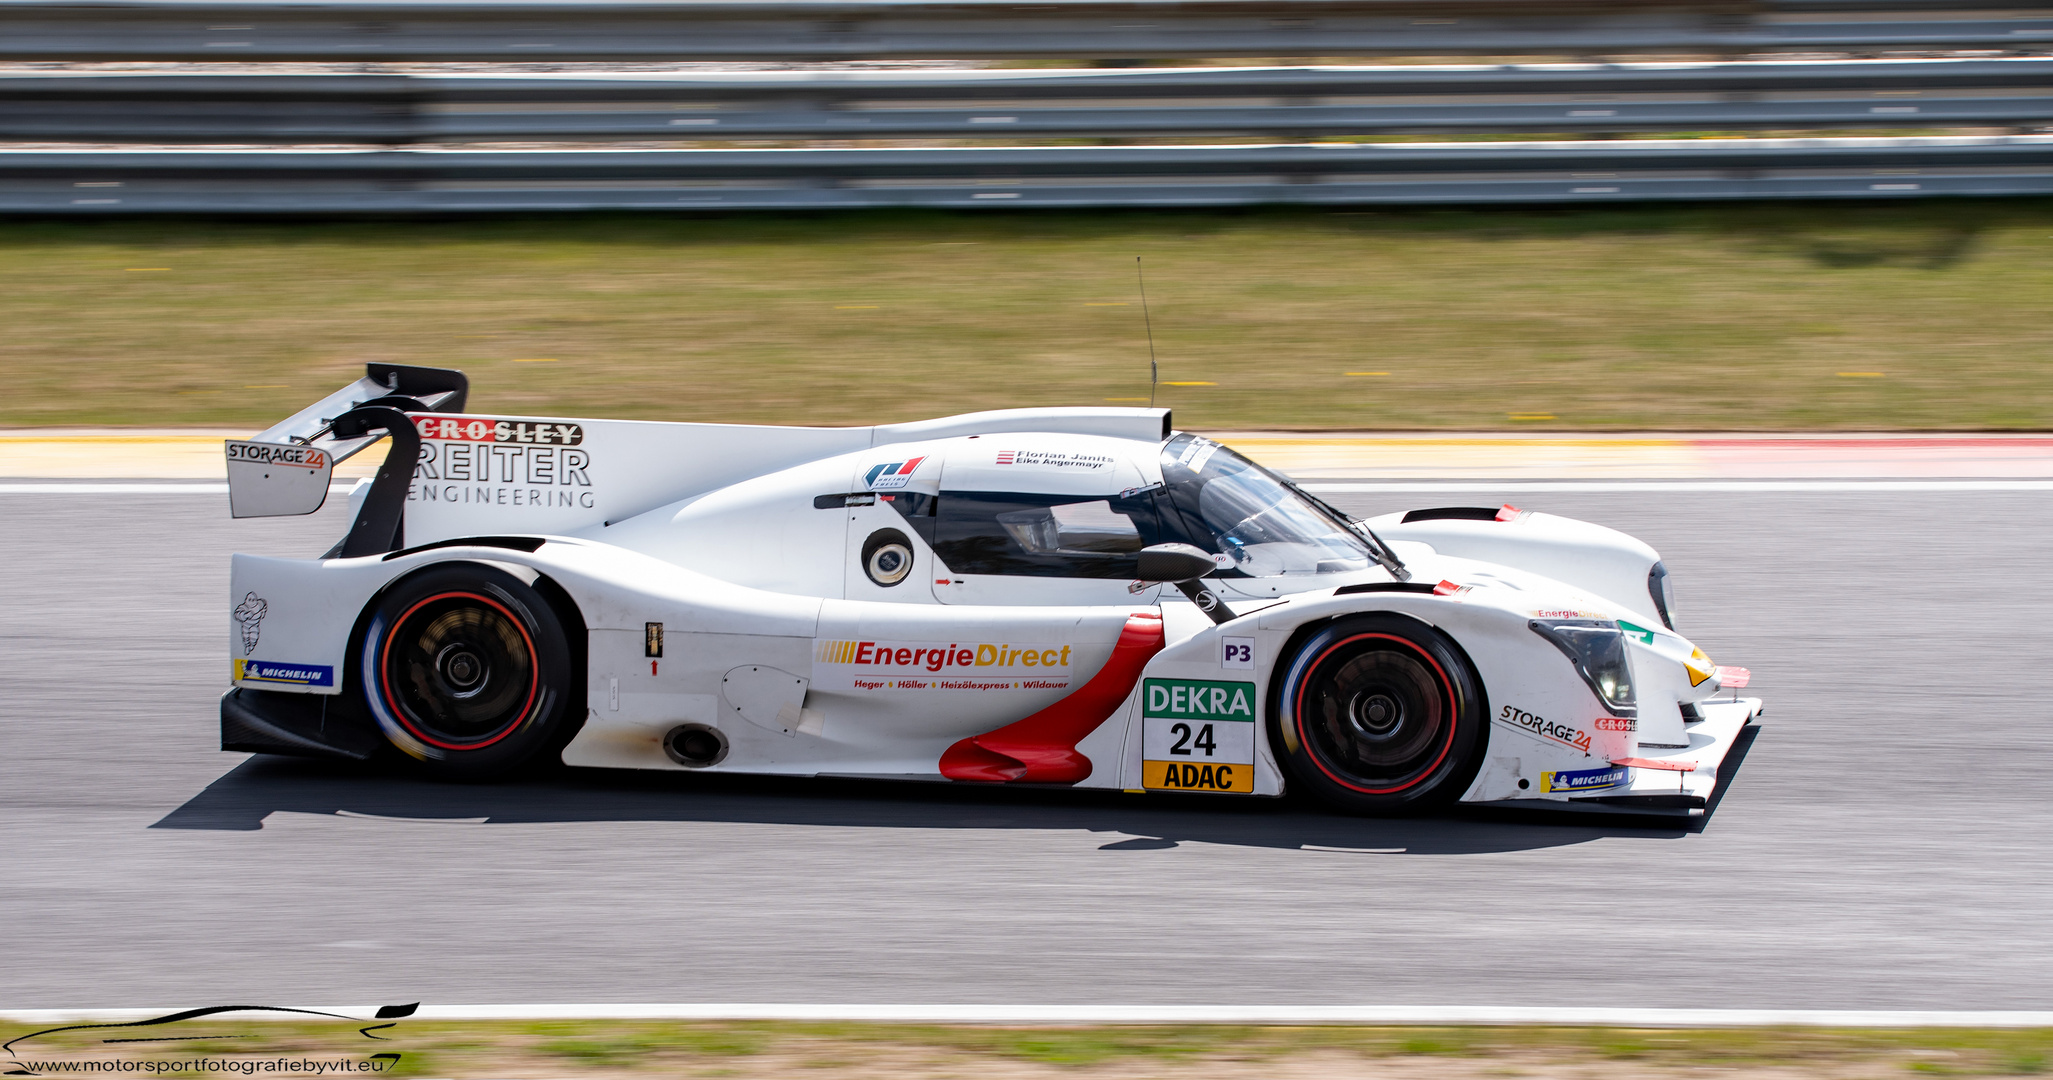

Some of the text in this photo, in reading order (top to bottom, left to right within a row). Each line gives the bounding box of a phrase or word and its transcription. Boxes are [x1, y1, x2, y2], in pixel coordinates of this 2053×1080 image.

[416, 418, 582, 445] CROSLEY
[228, 444, 325, 469] STORAGE24
[411, 442, 593, 487] REITER
[1017, 450, 1115, 463] Florian Janits
[1042, 459, 1104, 469] Angermayr
[407, 484, 595, 509] ENGINEERING
[854, 641, 1072, 672] EnergieDirect
[1225, 644, 1251, 662] P3
[261, 667, 323, 680] MICHELIN
[854, 678, 1069, 692] Heger Höller Heizölexpress Wildauer
[1148, 684, 1252, 717] DEKRA
[1169, 722, 1217, 757] 24
[1500, 705, 1592, 752] STORAGE24
[1163, 764, 1233, 790] ADAC
[1570, 771, 1625, 786] MICHELIN
